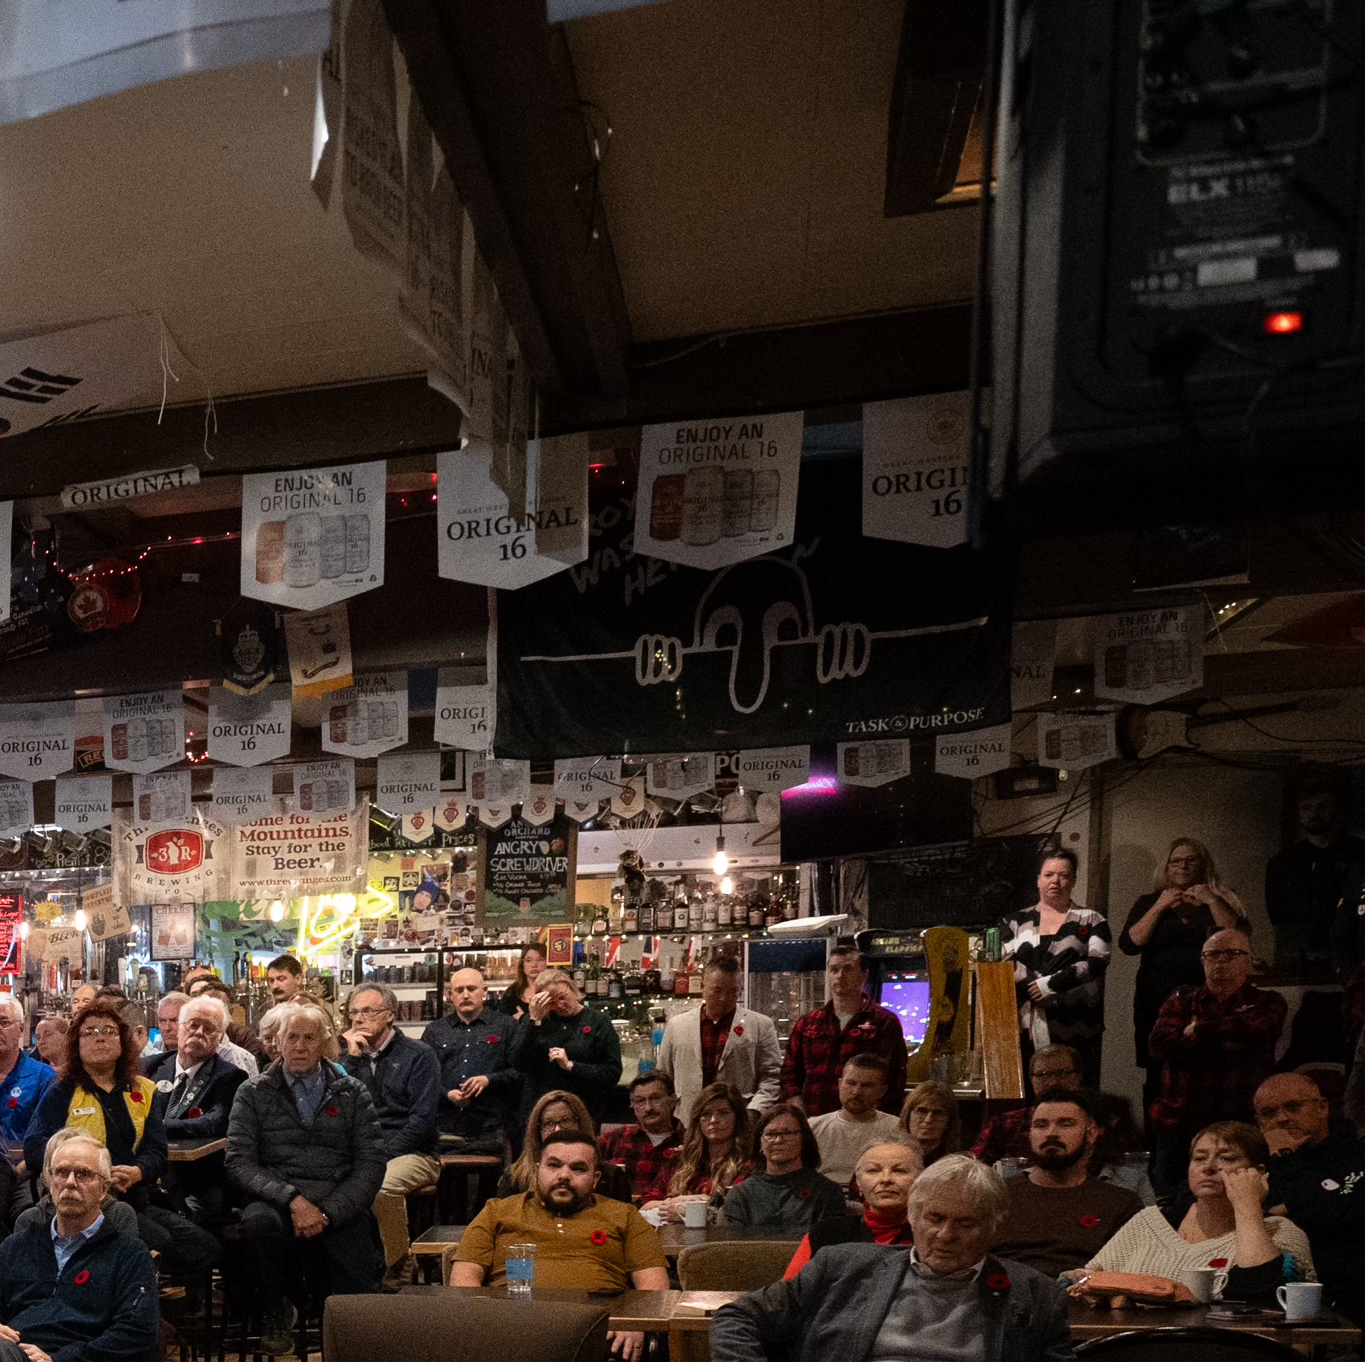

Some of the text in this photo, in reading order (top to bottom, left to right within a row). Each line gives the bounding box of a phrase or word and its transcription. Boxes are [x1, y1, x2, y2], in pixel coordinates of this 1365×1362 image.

[676, 422, 765, 444] ENJOY AN
[658, 440, 779, 465] ORIGINAL 16
[70, 468, 193, 507] ORIGINAL
[260, 487, 367, 513] ORIGINAL 16
[930, 492, 963, 518] 16
[498, 534, 527, 562] 16
[213, 721, 285, 738] ORIGINAL
[845, 717, 889, 735] TASK
[908, 707, 985, 732] PURPOSE
[1, 739, 70, 752] ORIGINAL
[939, 743, 1006, 758] ORIGINAL
[27, 752, 43, 767] 16
[743, 757, 805, 773] ORIGINAL
[379, 781, 437, 795] ORIGINAL
[57, 802, 109, 814] ORIGINAL
[239, 824, 353, 842] Mountains,
[441, 832, 475, 847] Prices
[245, 840, 346, 859] Stay for the
[493, 840, 540, 856] ANGRY
[273, 855, 324, 871] Beer.
[490, 856, 569, 873] SCREWDRIVER
[133, 868, 215, 887] BREWING
[155, 905, 191, 915] CHEERS
